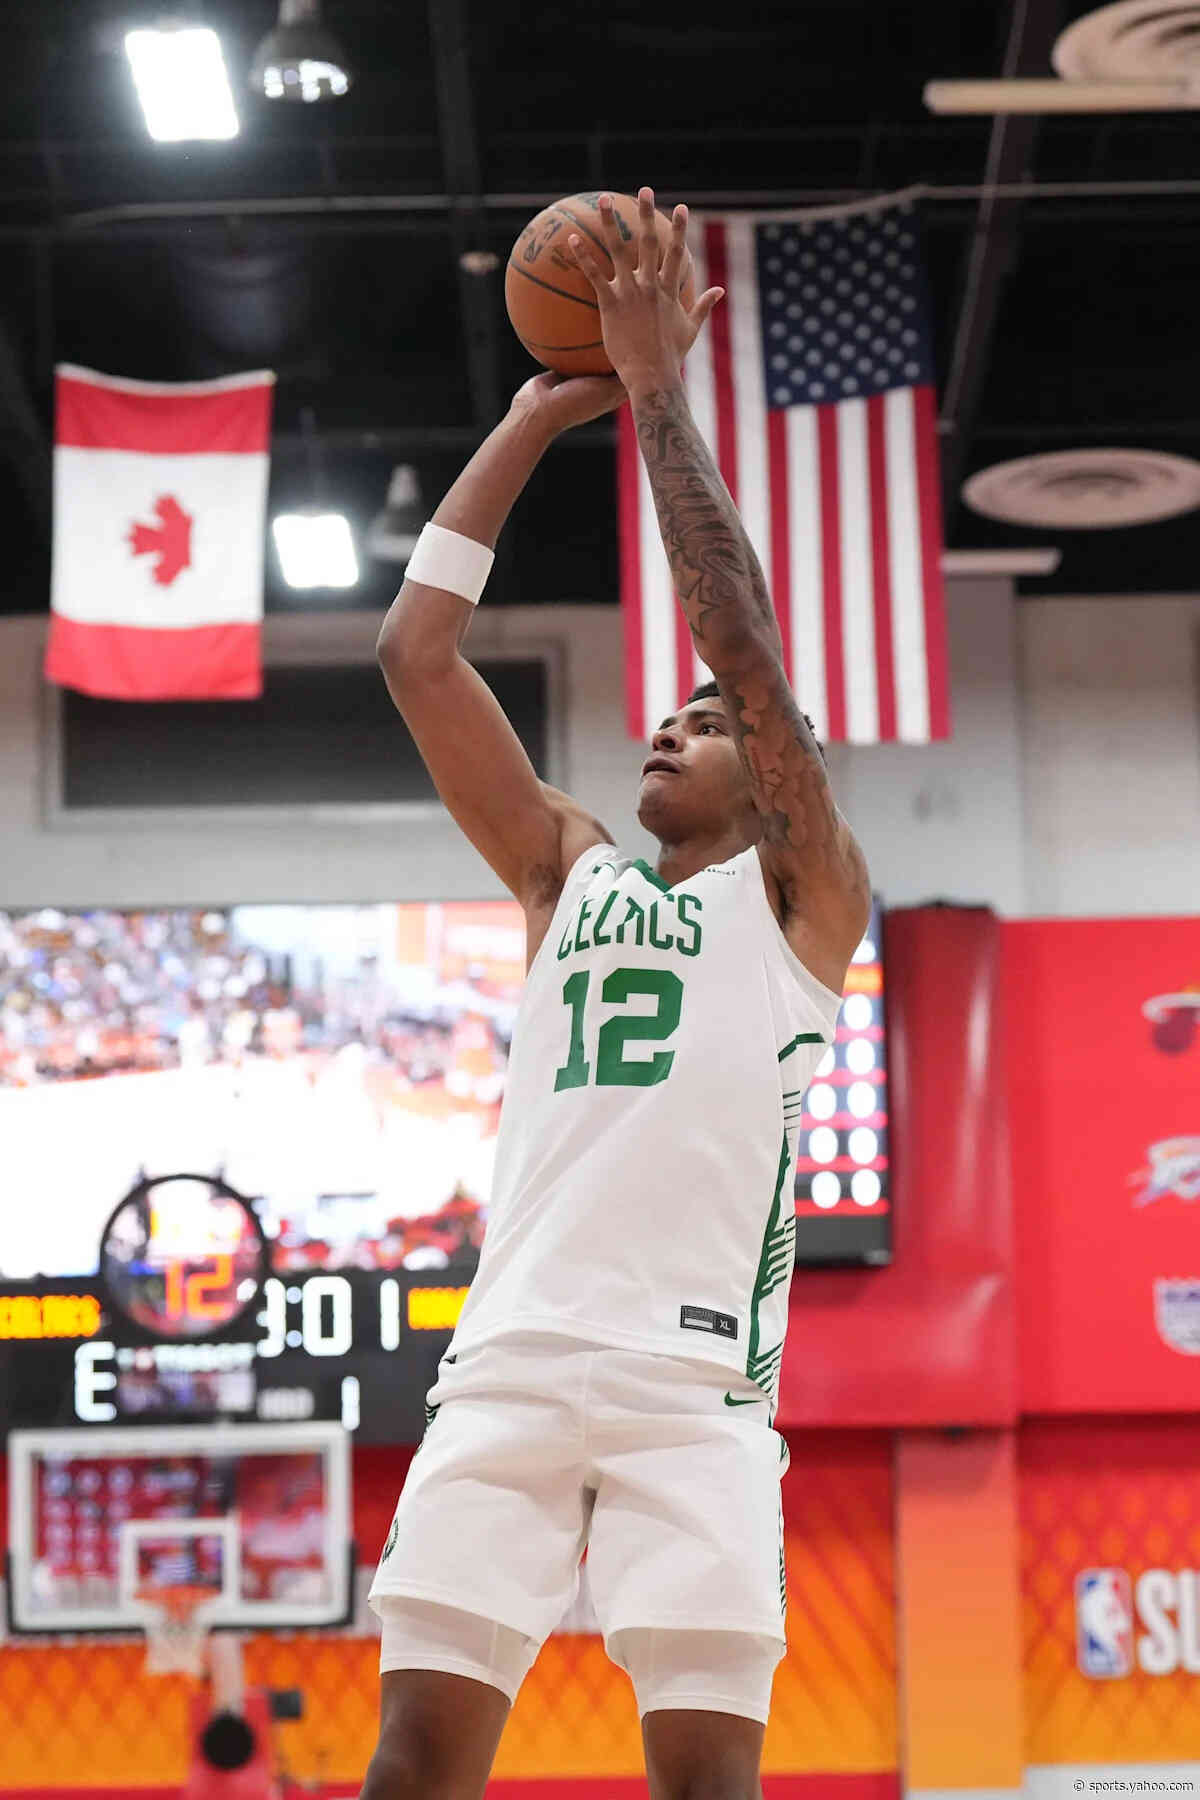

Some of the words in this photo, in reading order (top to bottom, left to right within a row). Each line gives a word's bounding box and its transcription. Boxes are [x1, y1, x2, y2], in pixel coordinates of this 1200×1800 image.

[554, 967, 684, 1092] 12
[163, 1254, 235, 1319] 12
[719, 1319, 731, 1331] XL
